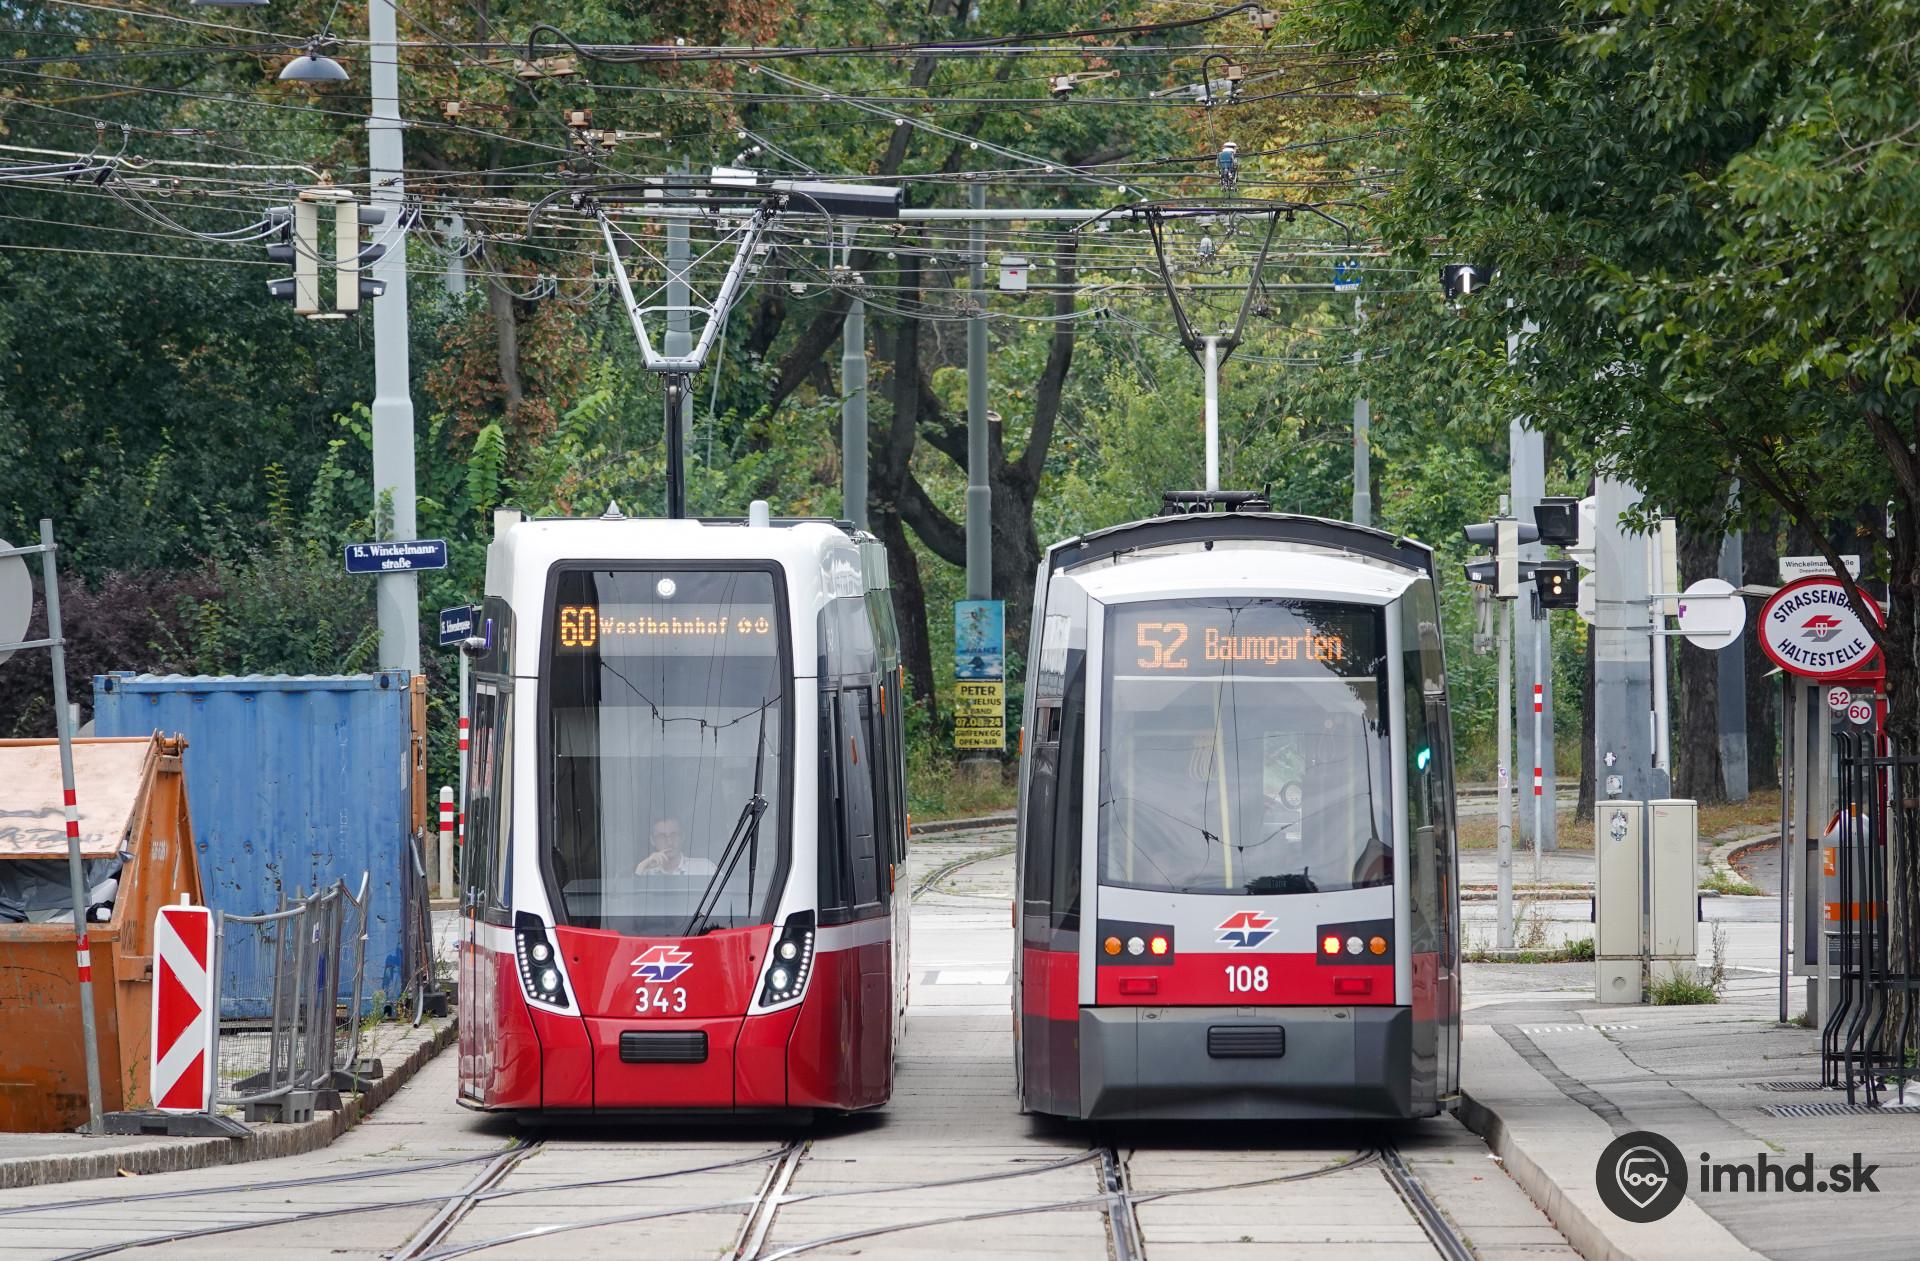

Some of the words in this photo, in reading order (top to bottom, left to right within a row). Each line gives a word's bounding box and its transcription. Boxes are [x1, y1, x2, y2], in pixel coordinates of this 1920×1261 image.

[370, 544, 439, 557] Winckelmann-
[381, 557, 412, 570] straße
[1773, 589, 1863, 623] STRASSENBA
[560, 606, 597, 647] 60
[600, 616, 728, 635] Westbahnhof
[1137, 622, 1189, 668] 52
[1205, 627, 1343, 665] Baumgarten
[1778, 638, 1867, 667] HALTESTELLE
[961, 686, 996, 696] PETER
[1829, 691, 1849, 706] 52
[1849, 705, 1871, 720] 60
[1224, 965, 1269, 993] 108
[635, 986, 687, 1013] 343
